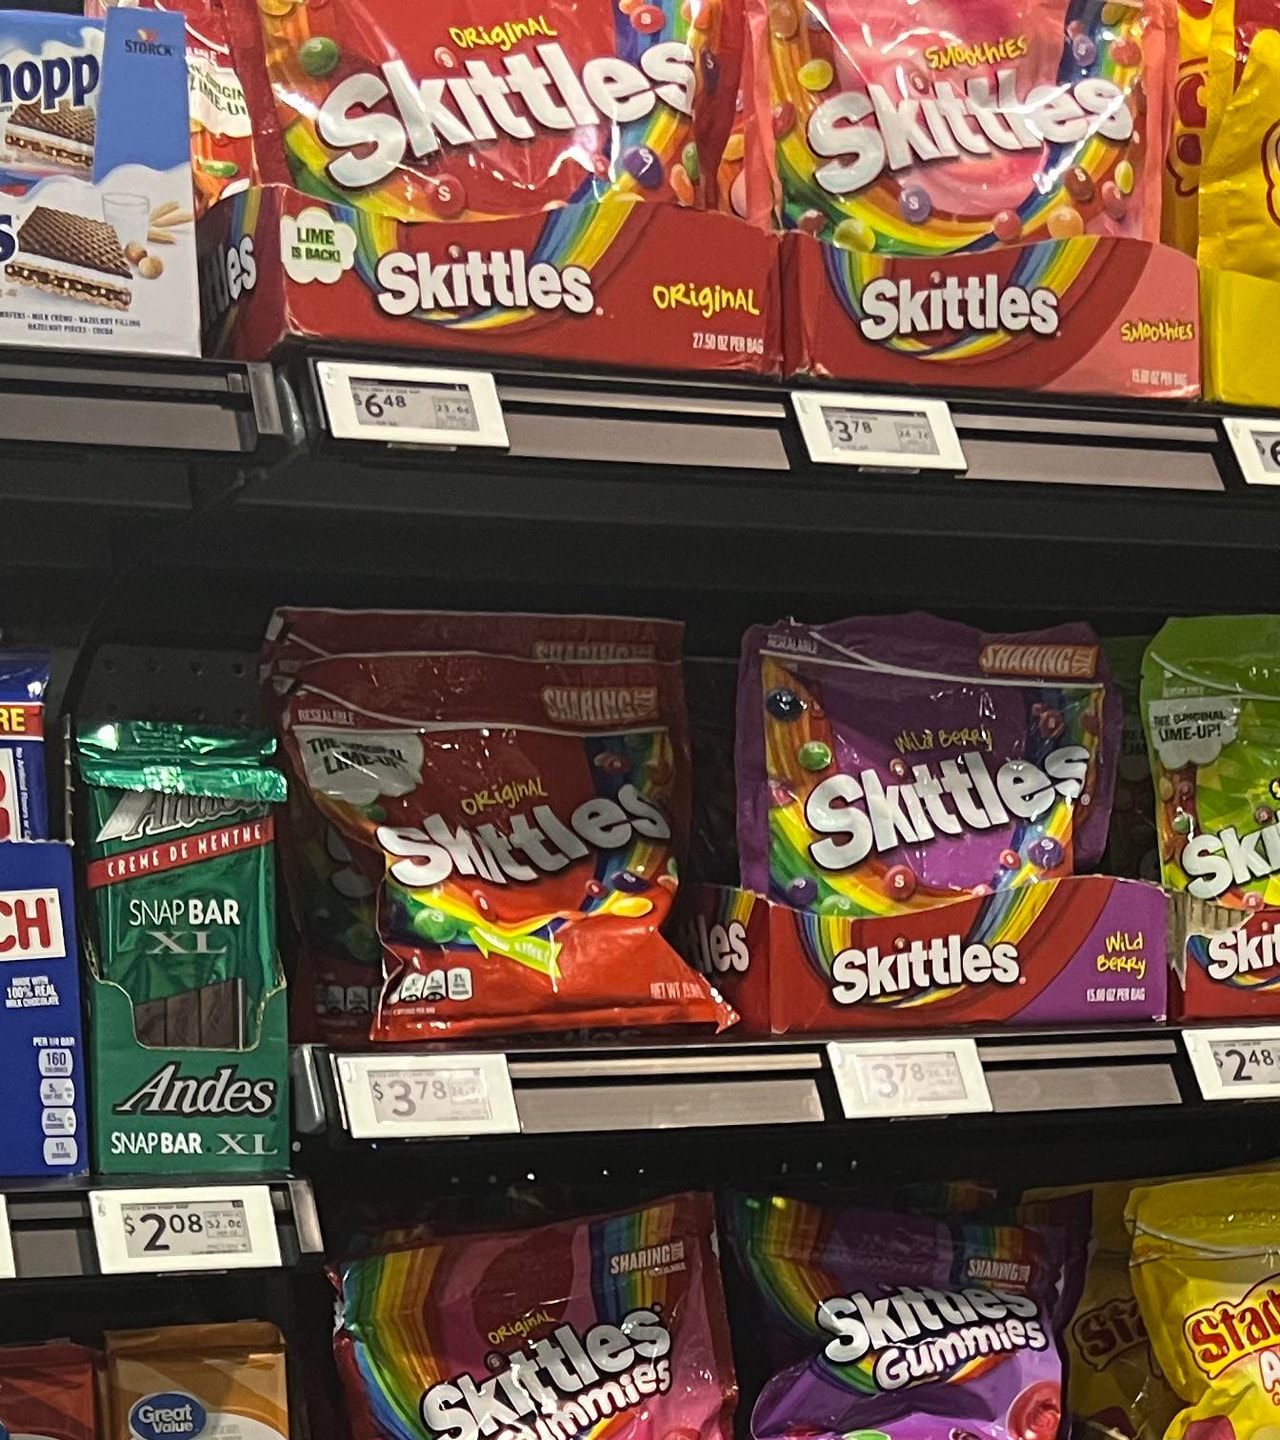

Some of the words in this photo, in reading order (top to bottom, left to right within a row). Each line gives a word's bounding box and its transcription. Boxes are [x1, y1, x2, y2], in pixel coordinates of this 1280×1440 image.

[125, 40, 174, 57] STORCK
[320, 41, 695, 189] Skittles
[297, 226, 334, 246] LIME
[291, 246, 303, 261] IS
[376, 245, 595, 316] Skittles
[861, 272, 1059, 341] Skittles
[731, 336, 745, 352] PER
[747, 338, 763, 354] BAG
[108, 852, 160, 877] CREME
[170, 843, 188, 860] DE
[199, 824, 262, 853] MENTHE
[129, 900, 185, 926] SNAP
[189, 899, 240, 925] BAR
[146, 931, 228, 953] XL
[1105, 931, 1143, 953] Wild
[832, 936, 1019, 1002] Skittles
[7, 988, 33, 998] 100%
[34, 985, 57, 996] REAL
[119, 1065, 273, 1115] Andes
[611, 1246, 671, 1274] SHARING
[874, 1319, 1045, 1391] Gummies
